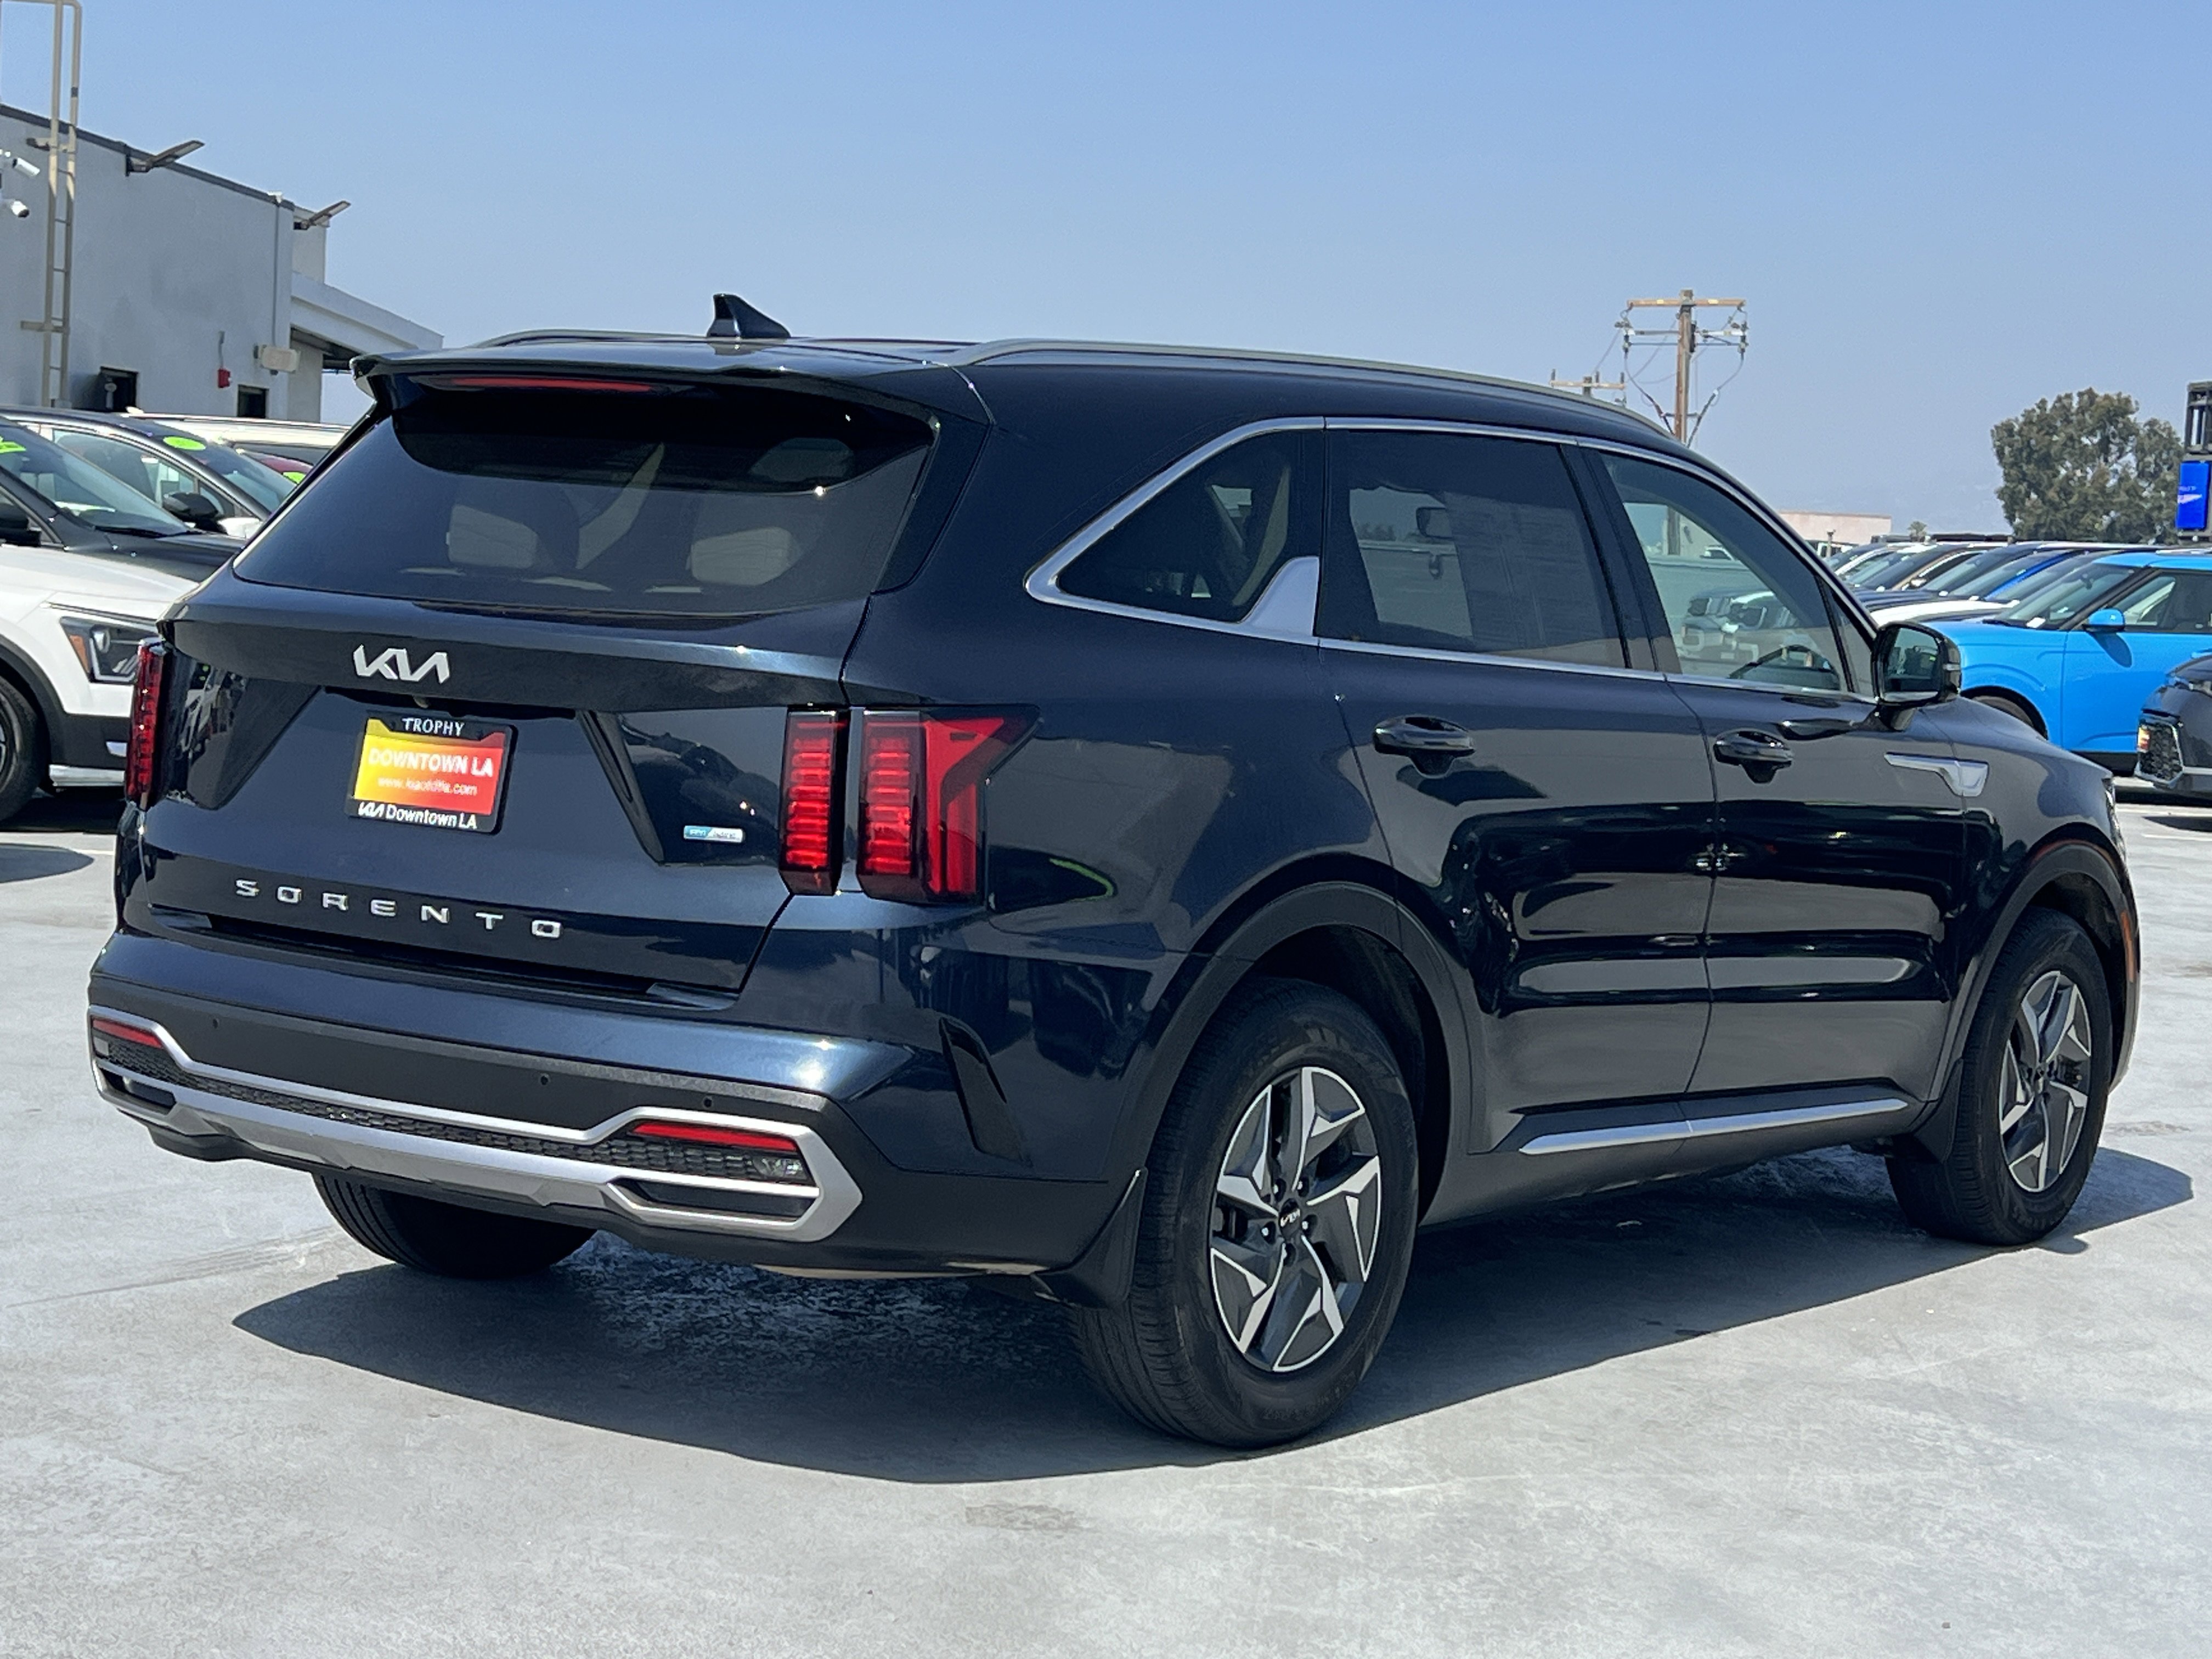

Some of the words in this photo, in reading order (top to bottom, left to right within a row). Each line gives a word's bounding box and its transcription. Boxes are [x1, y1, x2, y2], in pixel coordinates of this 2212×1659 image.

[353, 644, 450, 684] KIA
[402, 717, 465, 736] TROPHY
[368, 748, 468, 774] DOWNTOWN
[471, 757, 493, 777] LA
[358, 801, 385, 817] KIA
[386, 804, 458, 827] Downtown
[459, 813, 477, 830] LA
[235, 879, 564, 939] SORENTO
